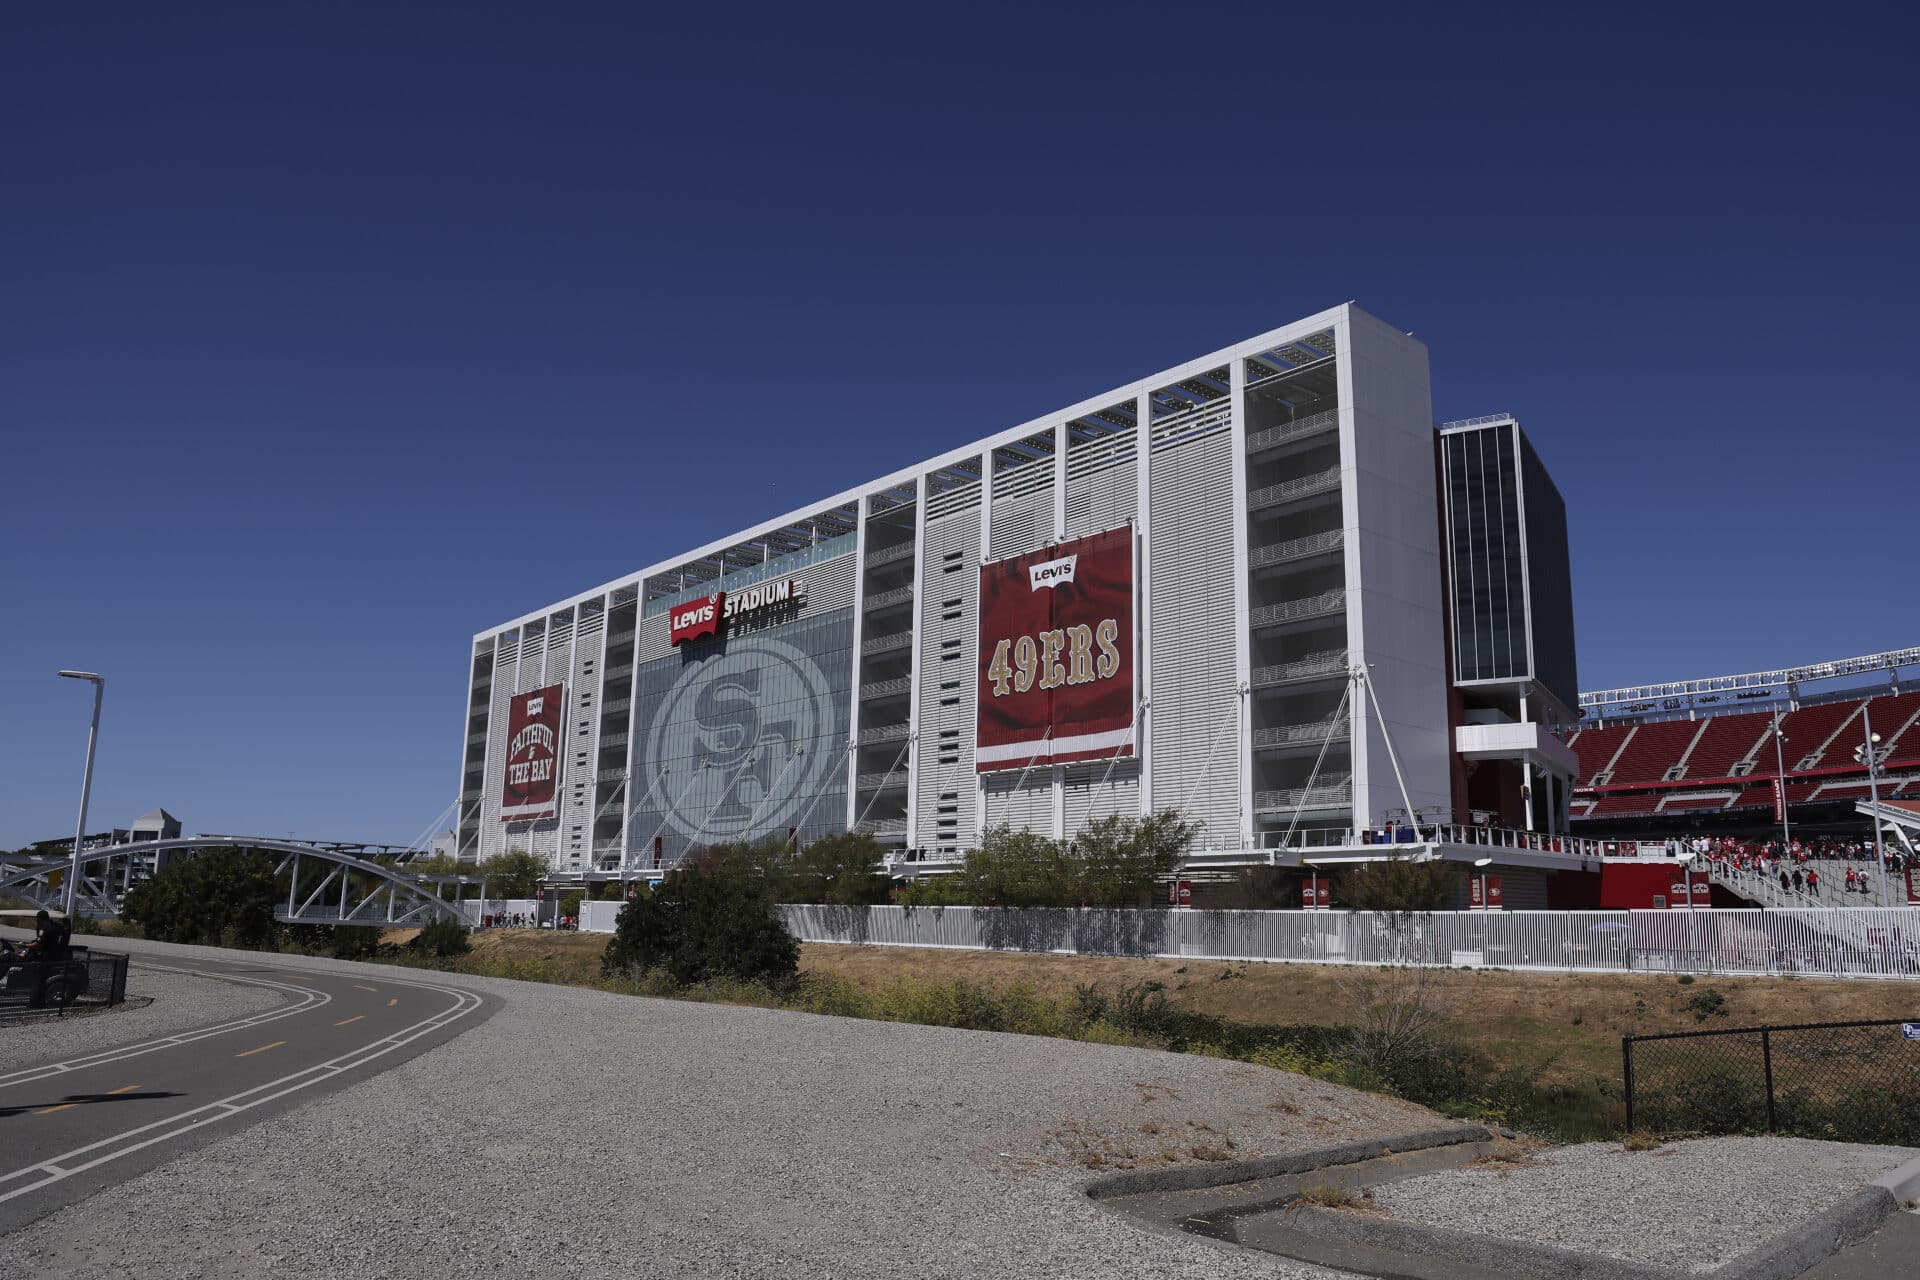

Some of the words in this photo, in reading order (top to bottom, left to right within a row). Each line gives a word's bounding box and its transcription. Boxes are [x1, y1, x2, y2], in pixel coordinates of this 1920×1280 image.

[723, 580, 790, 618] STADIUM
[988, 618, 1120, 697] 49ERS
[510, 723, 553, 761] FAITHFUL
[510, 762, 530, 784] THE
[531, 758, 552, 781] BAY
